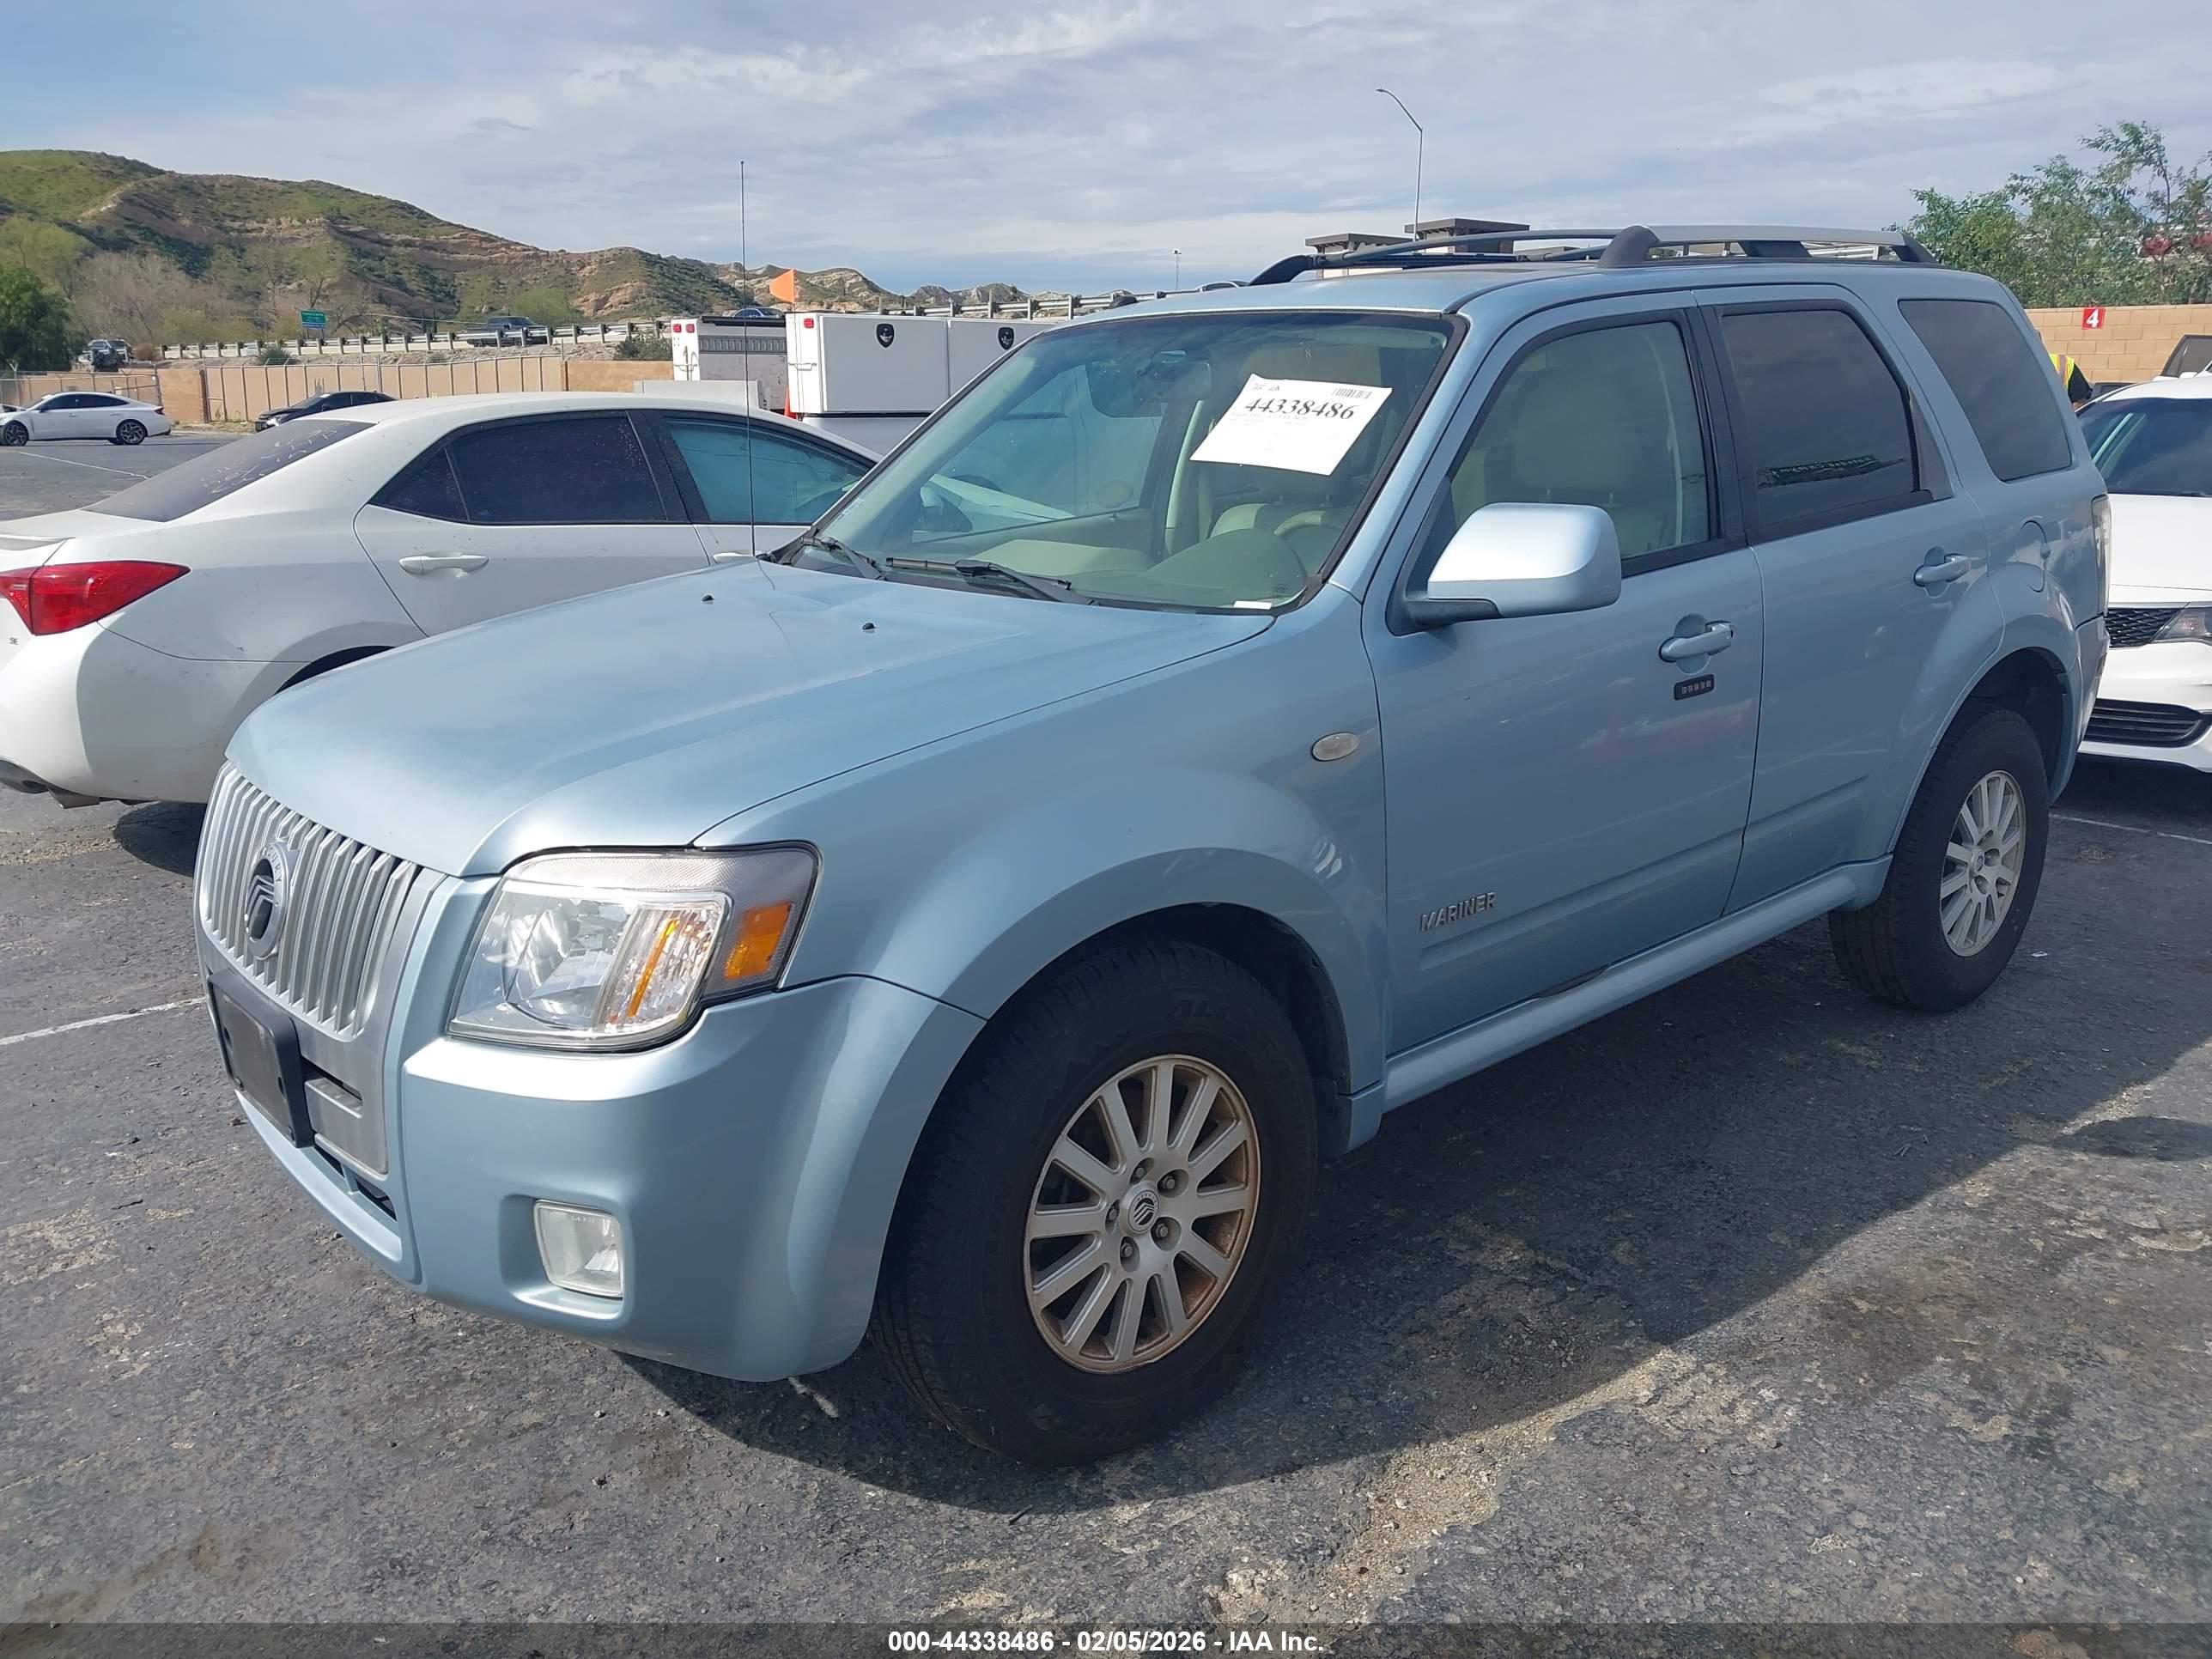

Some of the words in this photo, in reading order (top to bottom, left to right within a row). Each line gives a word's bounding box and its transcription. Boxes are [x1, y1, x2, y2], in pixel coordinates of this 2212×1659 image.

[2086, 308, 2100, 328] 4
[1245, 398, 1360, 420] 44338486
[1419, 891, 1496, 933] MARINER
